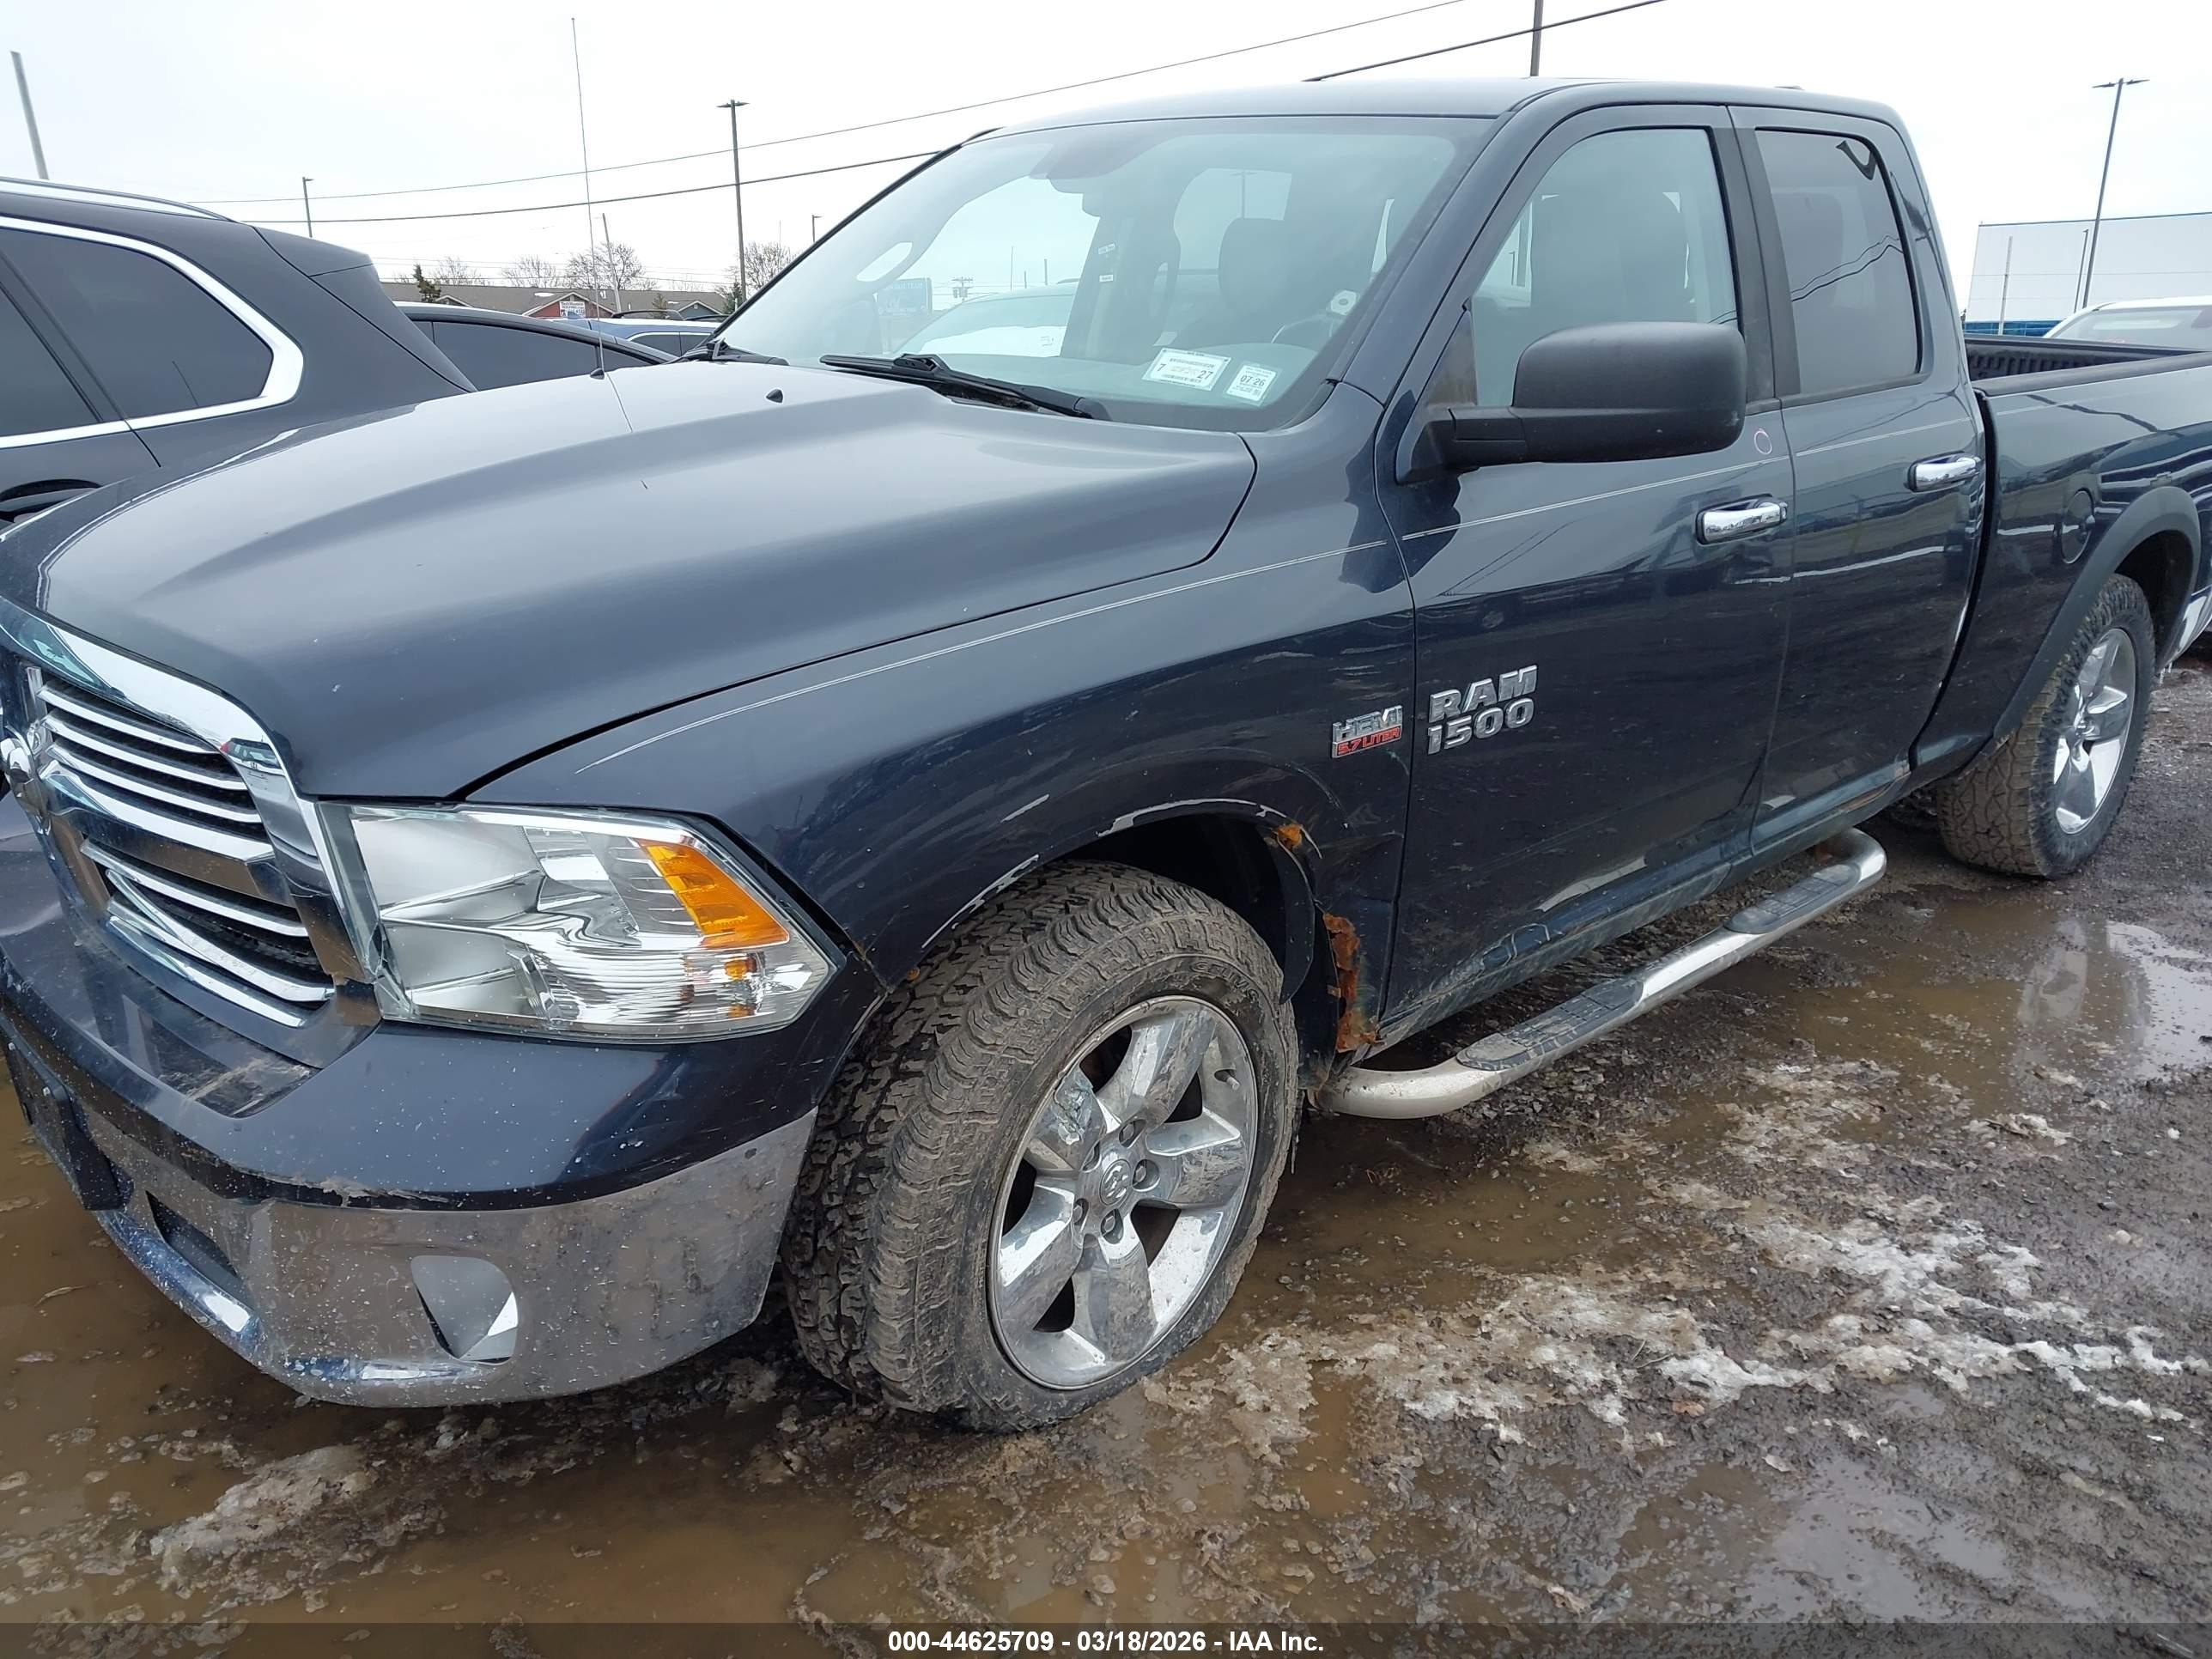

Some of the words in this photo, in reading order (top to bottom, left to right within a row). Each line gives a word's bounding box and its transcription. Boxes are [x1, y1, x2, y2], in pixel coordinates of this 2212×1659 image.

[1196, 370, 1214, 380] 27
[1429, 665, 1538, 723] RAM
[1332, 705, 1403, 744] HEMI
[1338, 738, 1362, 756] 5.7
[1362, 726, 1401, 749] LITER
[1427, 697, 1534, 755] 1500
